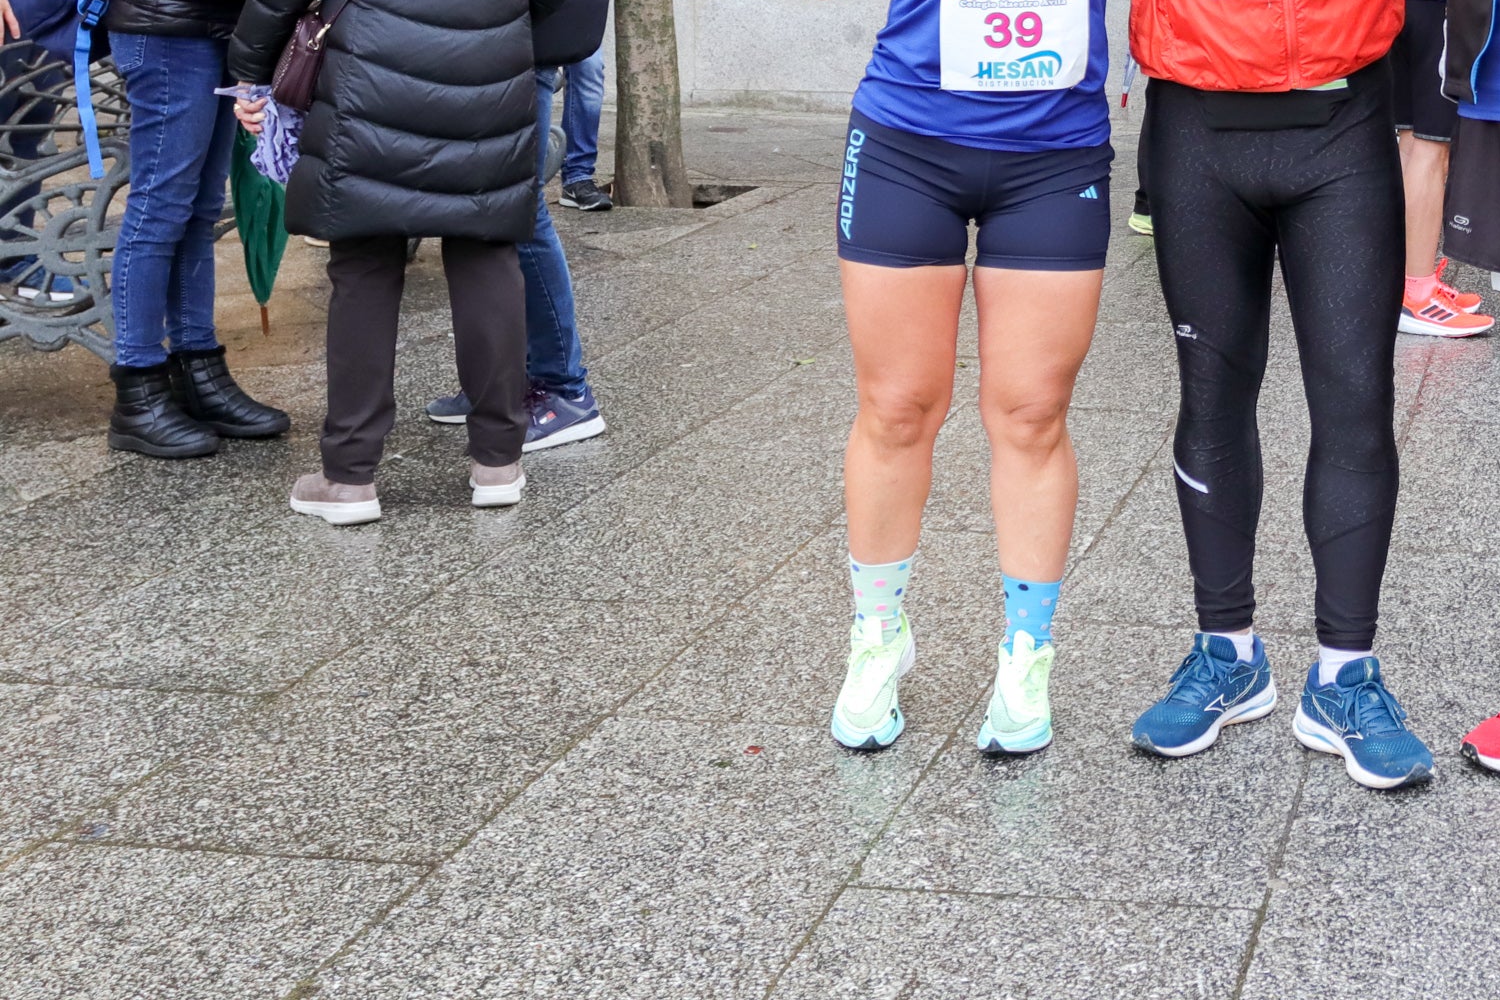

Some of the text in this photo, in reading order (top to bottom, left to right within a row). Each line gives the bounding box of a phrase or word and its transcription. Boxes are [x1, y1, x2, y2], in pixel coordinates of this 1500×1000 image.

[959, 0, 997, 10] Colegio
[983, 11, 1043, 49] 39
[976, 60, 1055, 80] HESAN
[977, 78, 1055, 88] DISTRIBUCIÓN
[840, 128, 866, 240] ADIZERO
